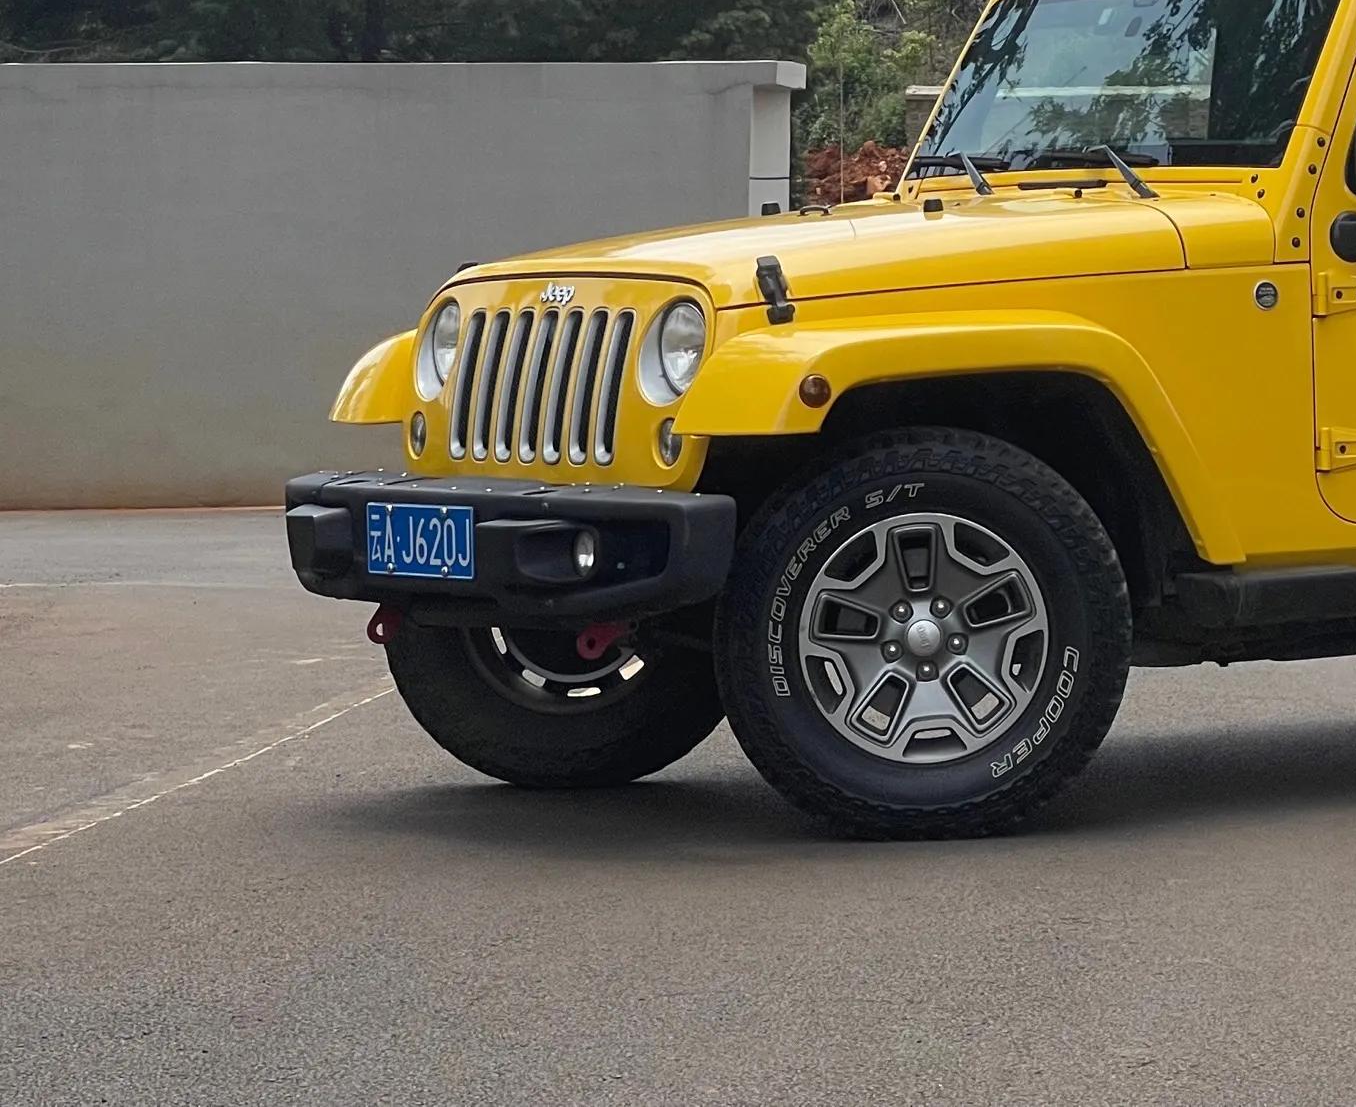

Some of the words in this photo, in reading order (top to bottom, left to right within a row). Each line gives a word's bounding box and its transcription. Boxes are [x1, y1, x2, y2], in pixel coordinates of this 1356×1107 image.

[540, 281, 575, 306] Jeep
[767, 505, 851, 698] DISCOVERER
[864, 482, 925, 509] S/T
[989, 645, 1080, 778] COOPER
